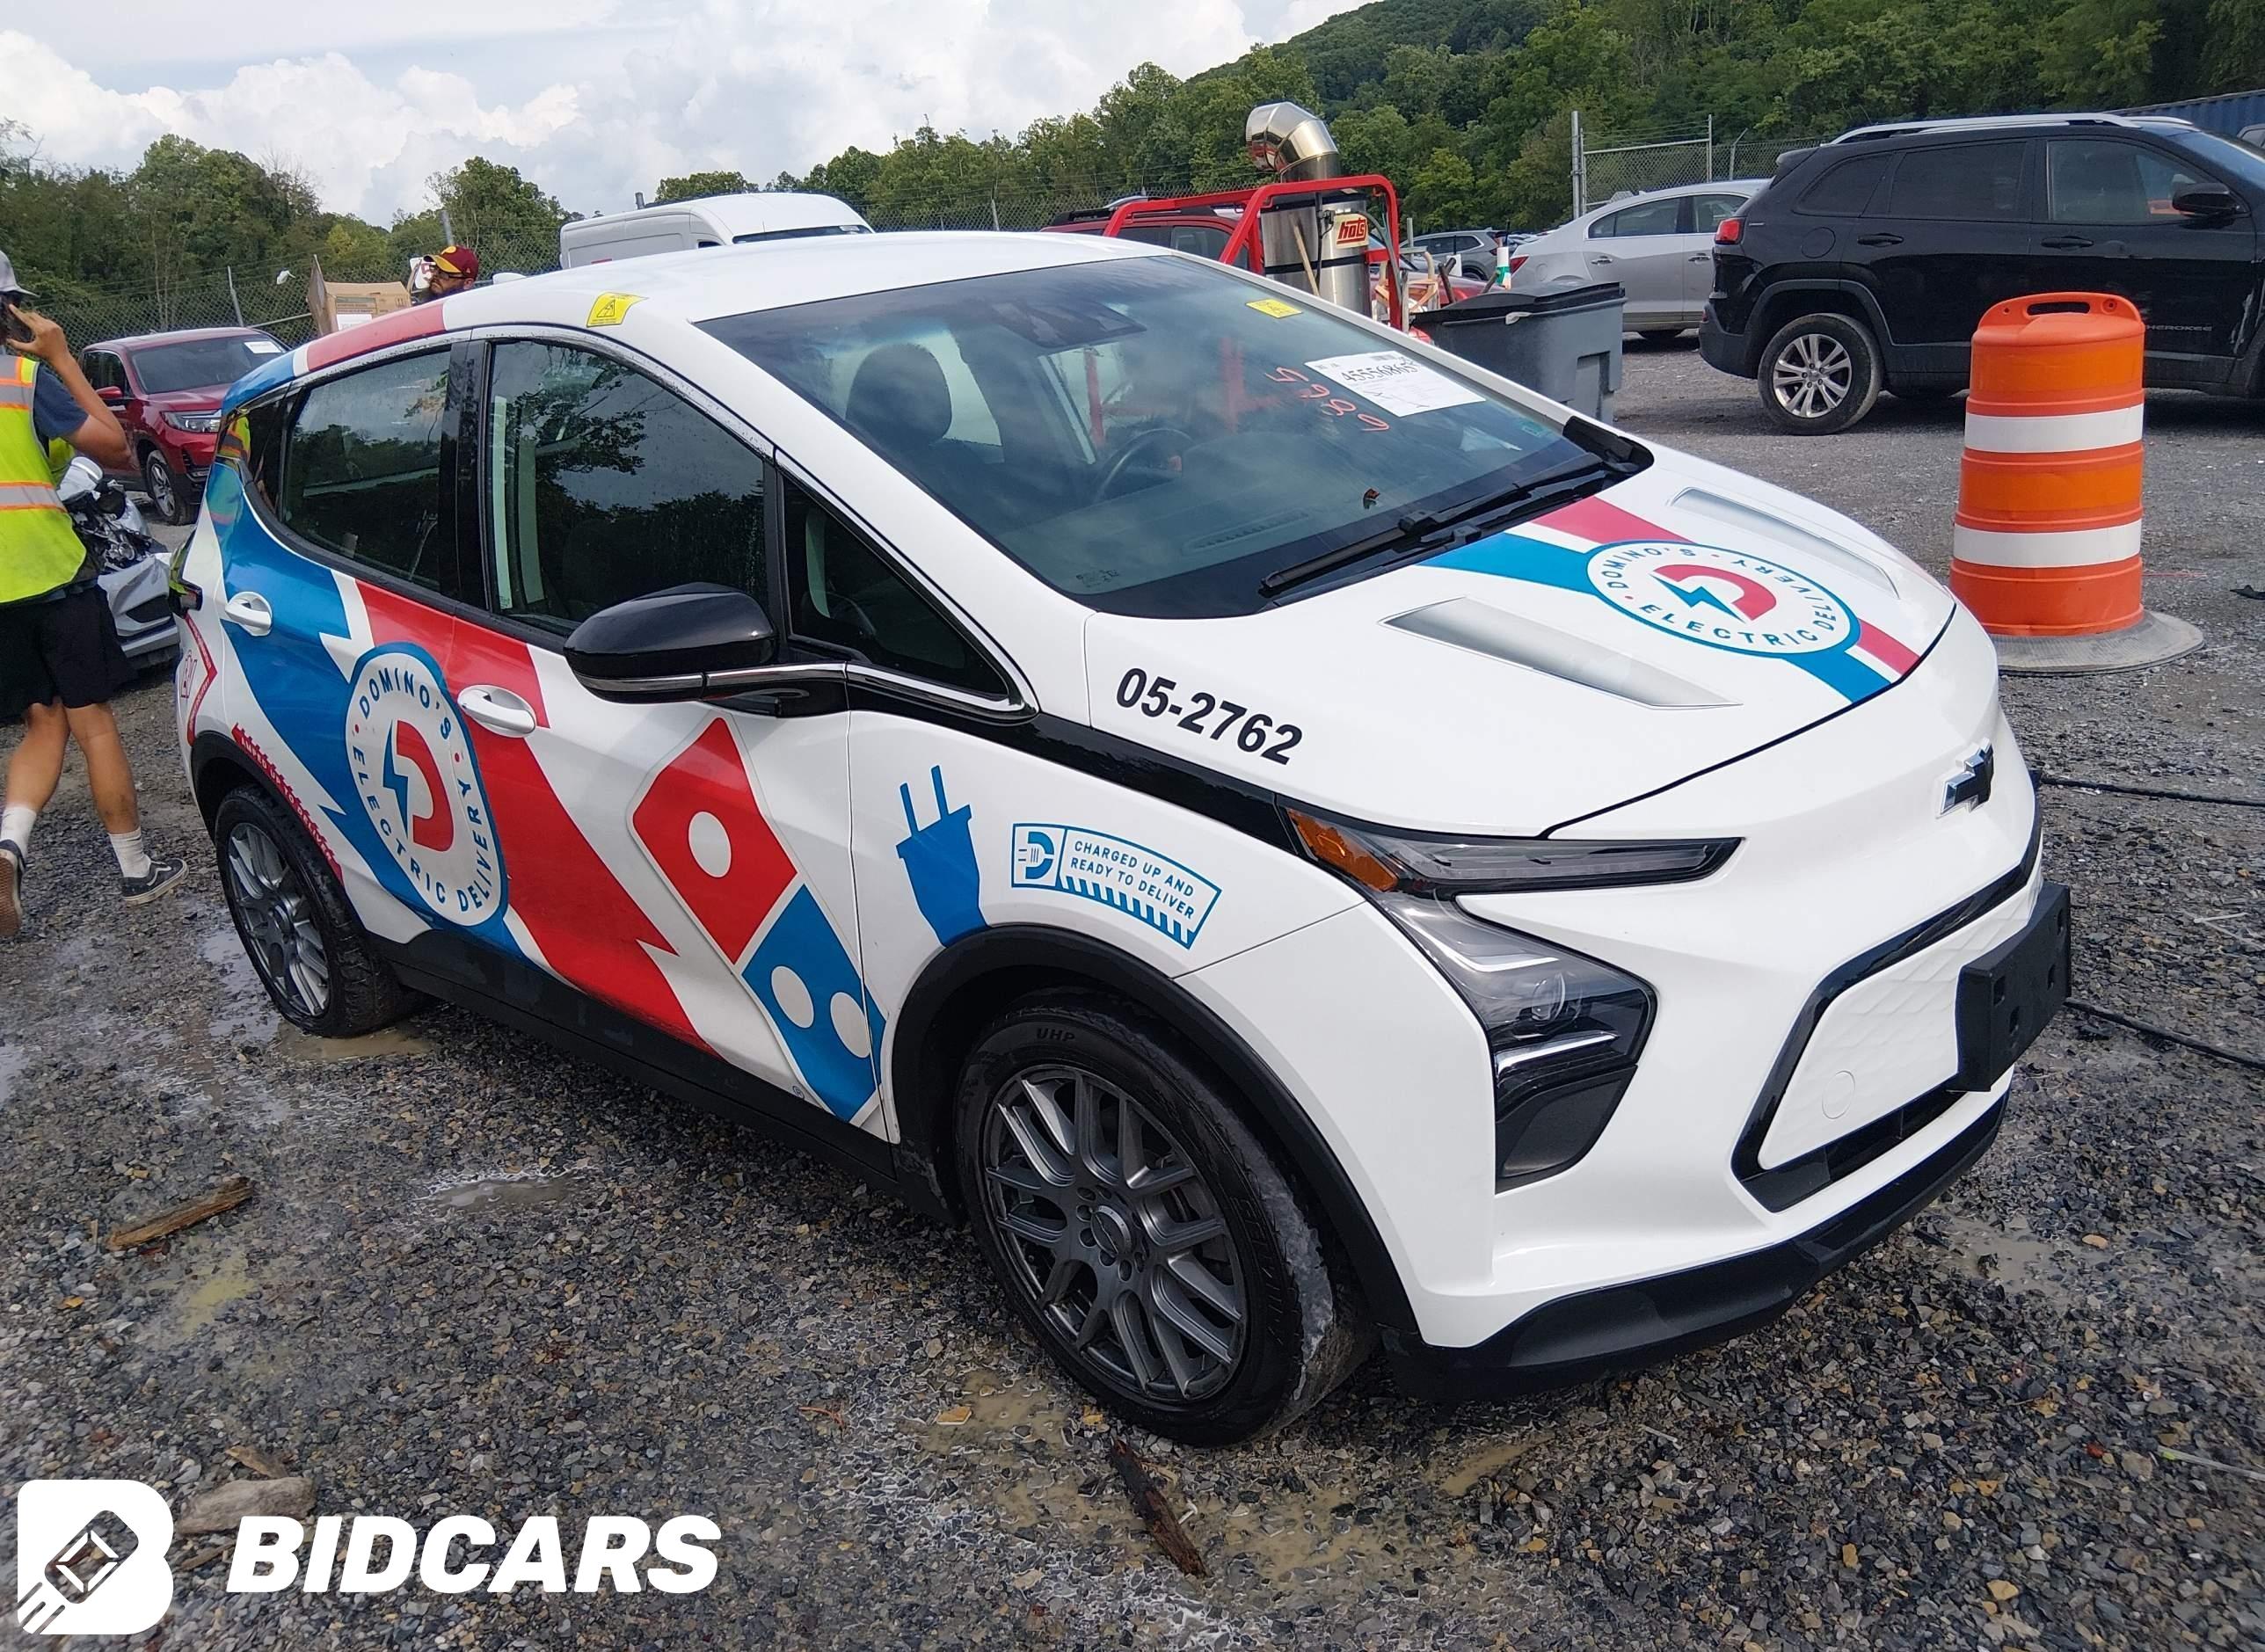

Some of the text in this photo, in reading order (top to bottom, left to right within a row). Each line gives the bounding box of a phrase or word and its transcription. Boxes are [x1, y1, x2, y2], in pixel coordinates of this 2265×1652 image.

[1601, 547, 1696, 591] DOMINO'S
[1640, 559, 1838, 646] ELECTRIC DELIVERY
[359, 667, 451, 740] DOMINO'S
[1117, 668, 1303, 766] 05-2762
[353, 745, 492, 912] ELECTRIC DELIVERY
[1070, 857, 1195, 920] READY TO DELIVER
[1074, 841, 1194, 897] CHARGED UP AND
[1037, 1028, 1075, 1042] UHP
